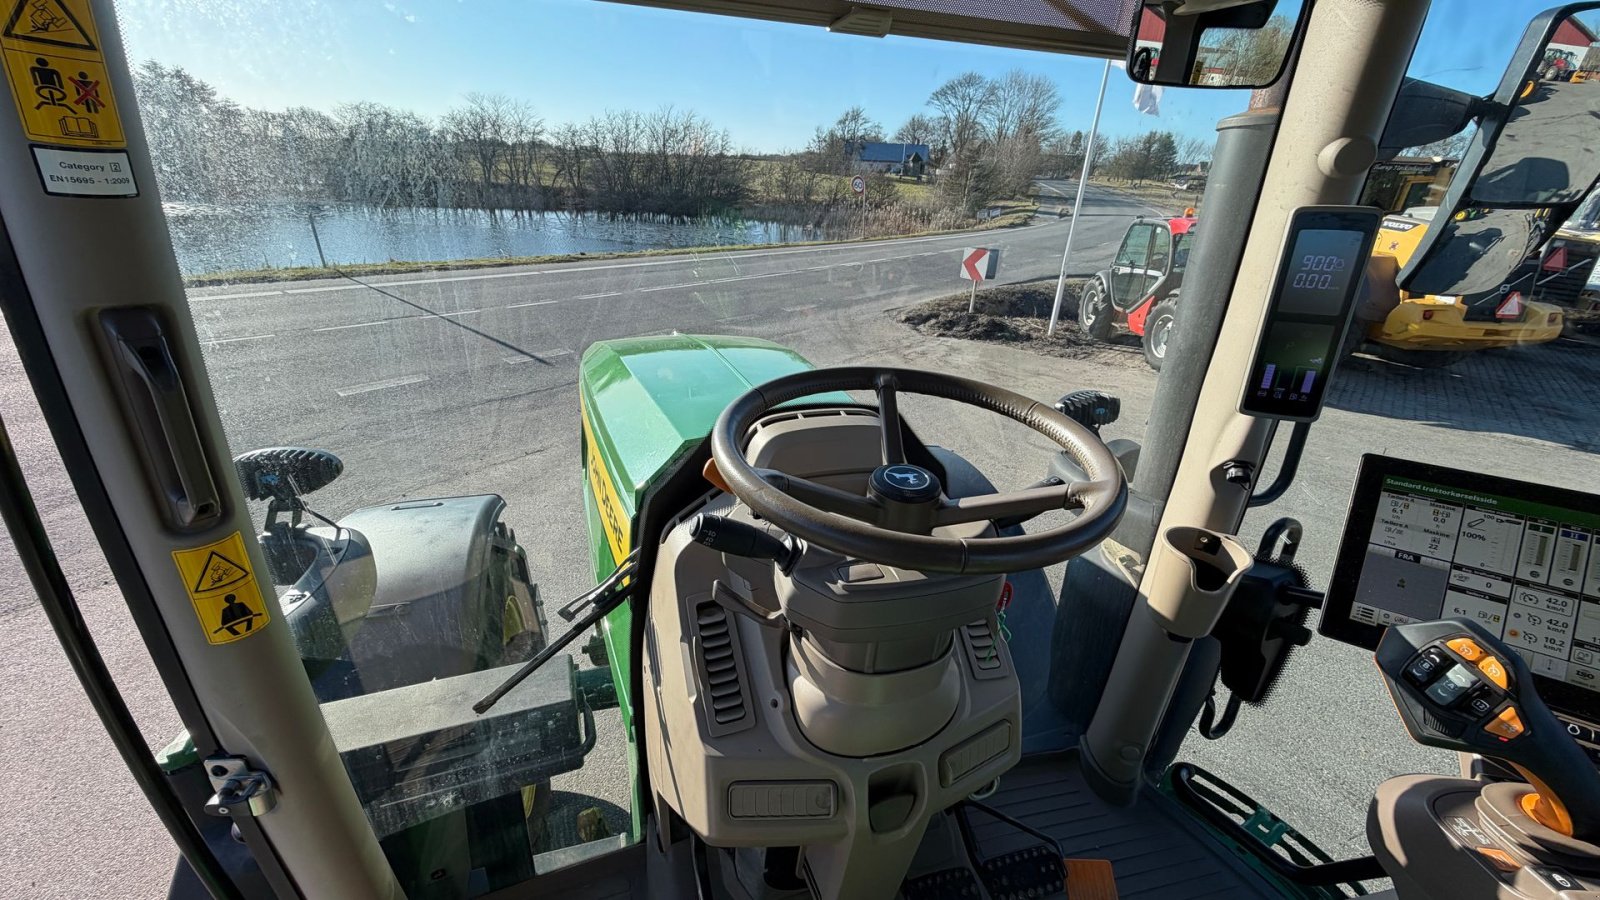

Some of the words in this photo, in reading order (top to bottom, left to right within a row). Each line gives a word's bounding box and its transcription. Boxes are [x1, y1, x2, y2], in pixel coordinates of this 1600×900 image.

[59, 161, 105, 172] Category
[49, 174, 95, 185] EN15695
[1301, 255, 1337, 272] 900
[1293, 273, 1332, 290] 0.00
[1386, 478, 1421, 490] Standard
[601, 479, 624, 555] DEERE
[1433, 516, 1446, 524] 0.0
[1424, 528, 1450, 538] Maskine
[1462, 531, 1487, 541] 100%
[1398, 552, 1414, 561] FRA
[1546, 598, 1568, 608] 42.0
[1453, 607, 1467, 616] 6.1
[1546, 619, 1569, 629] 42.0
[1544, 636, 1565, 647] 10.2
[1576, 669, 1595, 680] ISO
